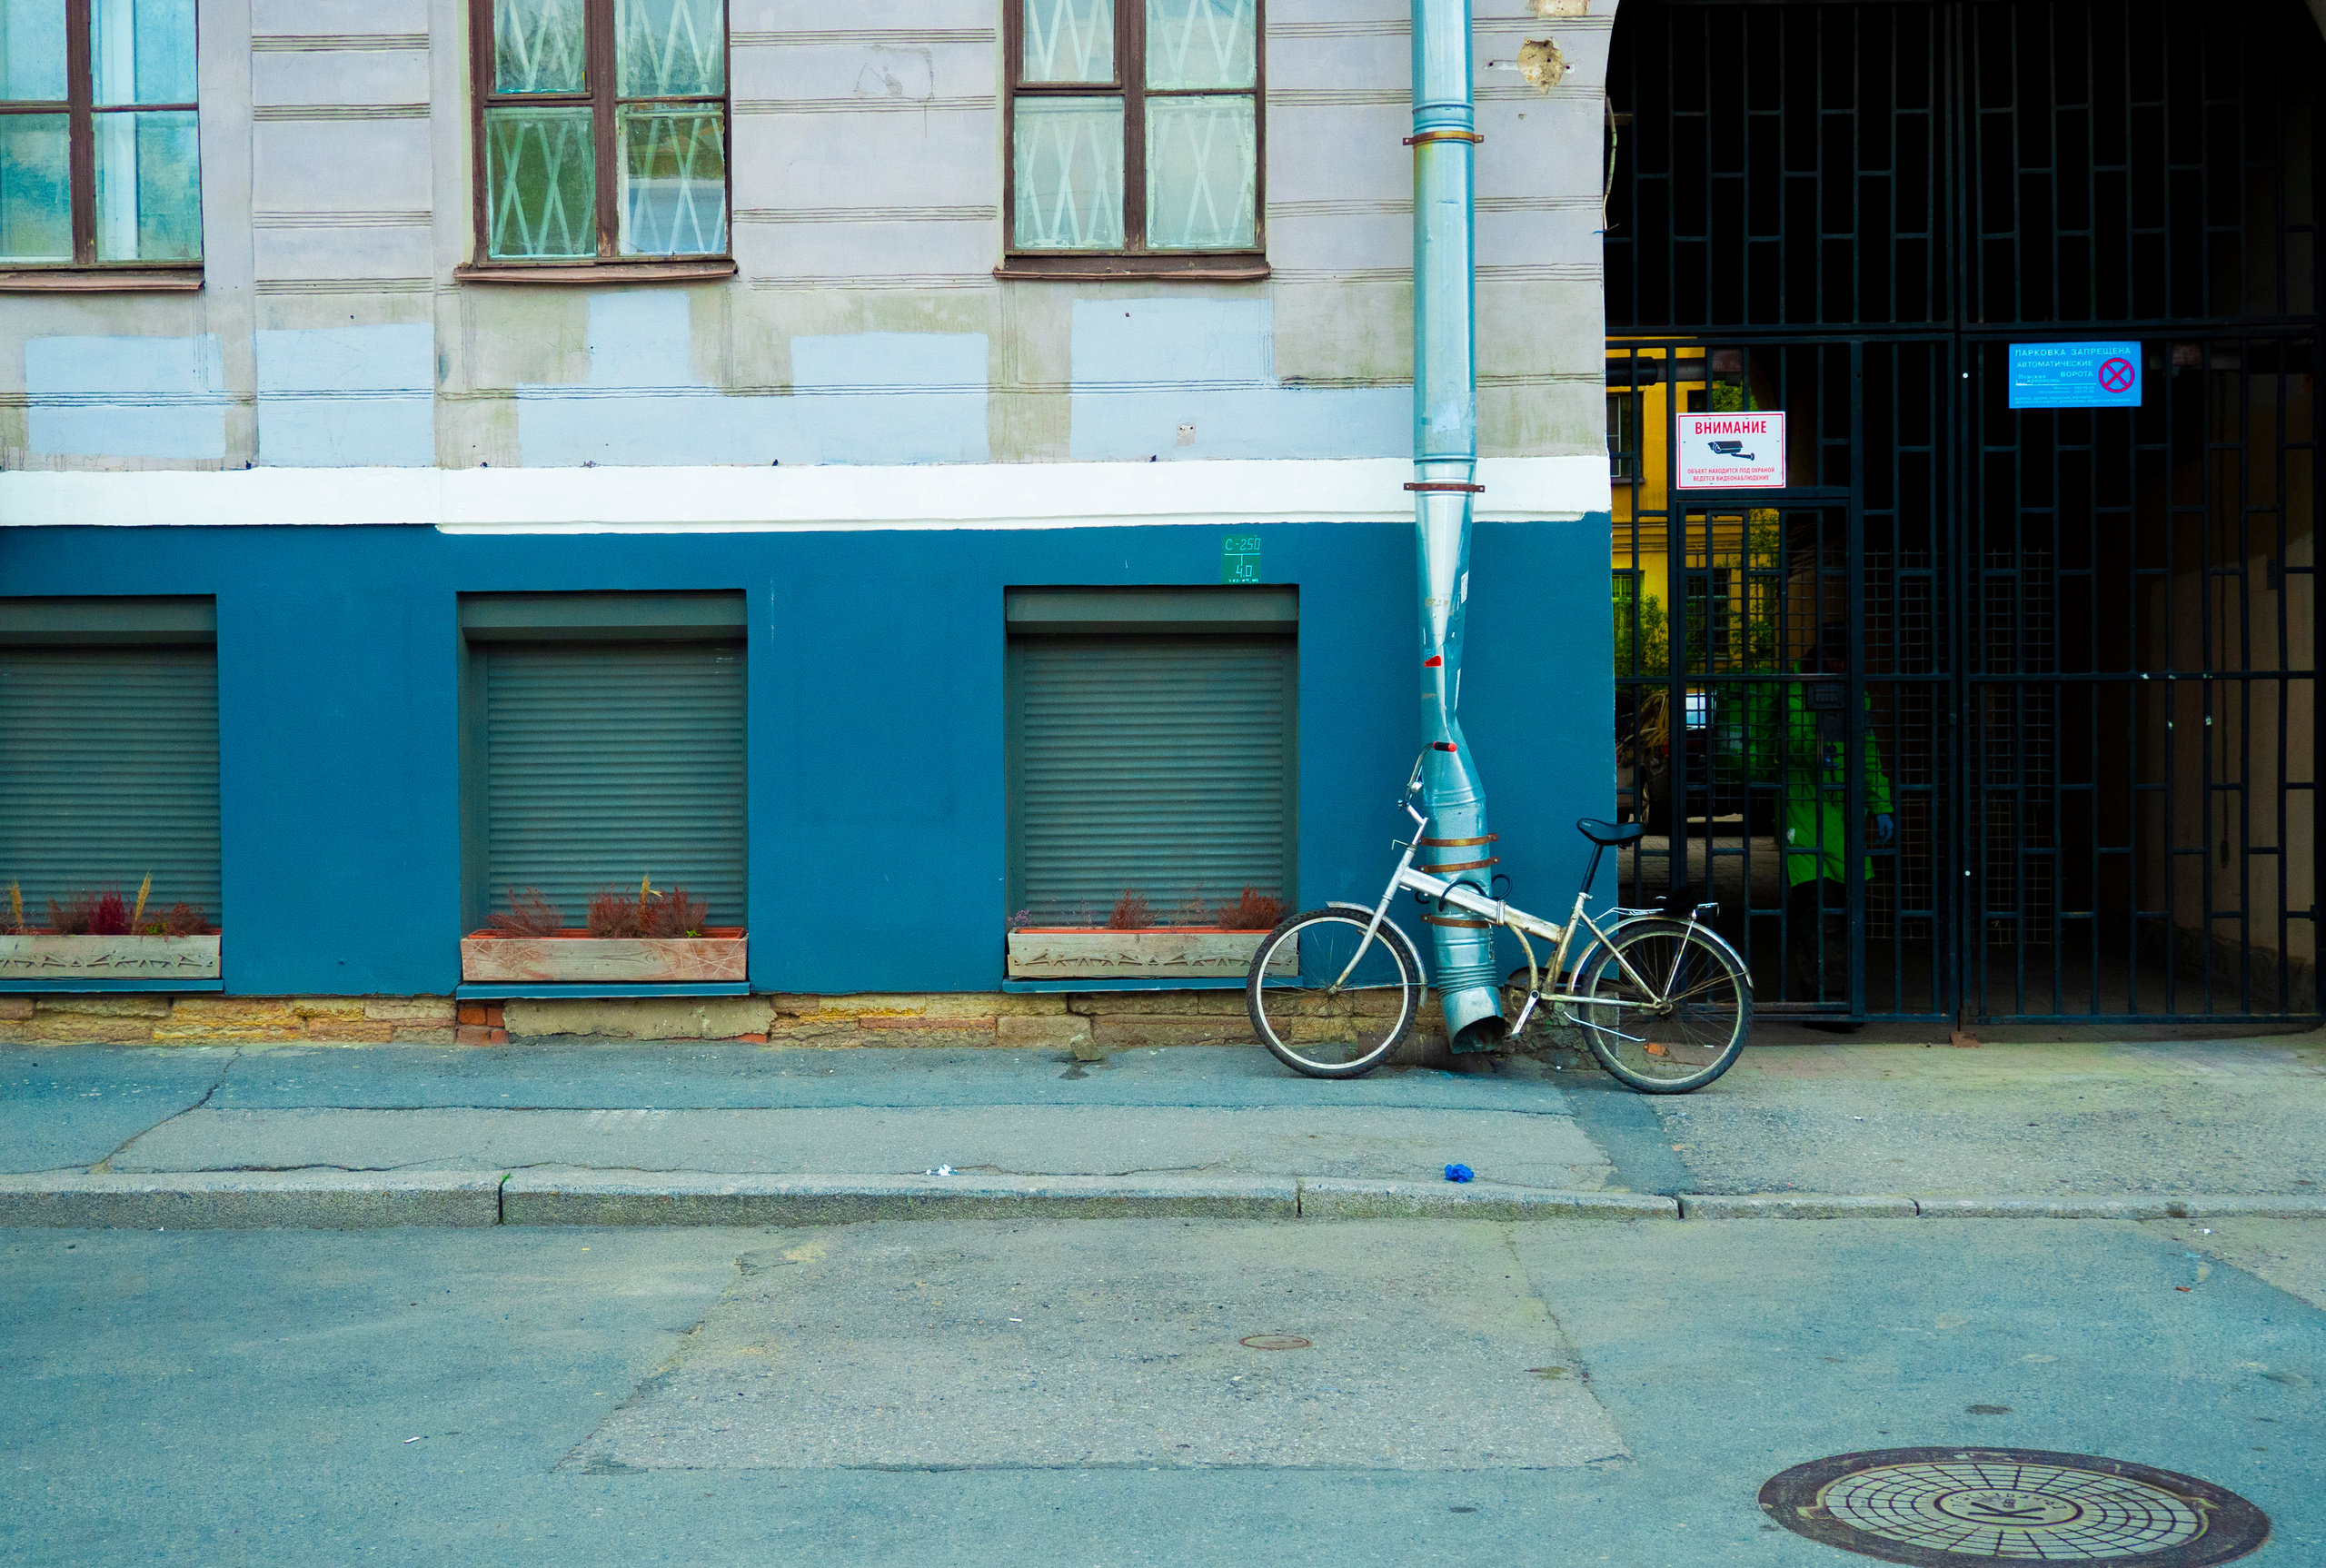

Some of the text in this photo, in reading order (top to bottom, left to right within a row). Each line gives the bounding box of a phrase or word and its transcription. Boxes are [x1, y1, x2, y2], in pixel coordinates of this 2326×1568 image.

[2015, 347, 2132, 357] ПАРКОВКА ЗАПРЕЩЕНА
[2016, 360, 2093, 368] АВТОМАТИЧЕСКИЕ
[1695, 421, 1767, 434] ВНИМАНИЕ
